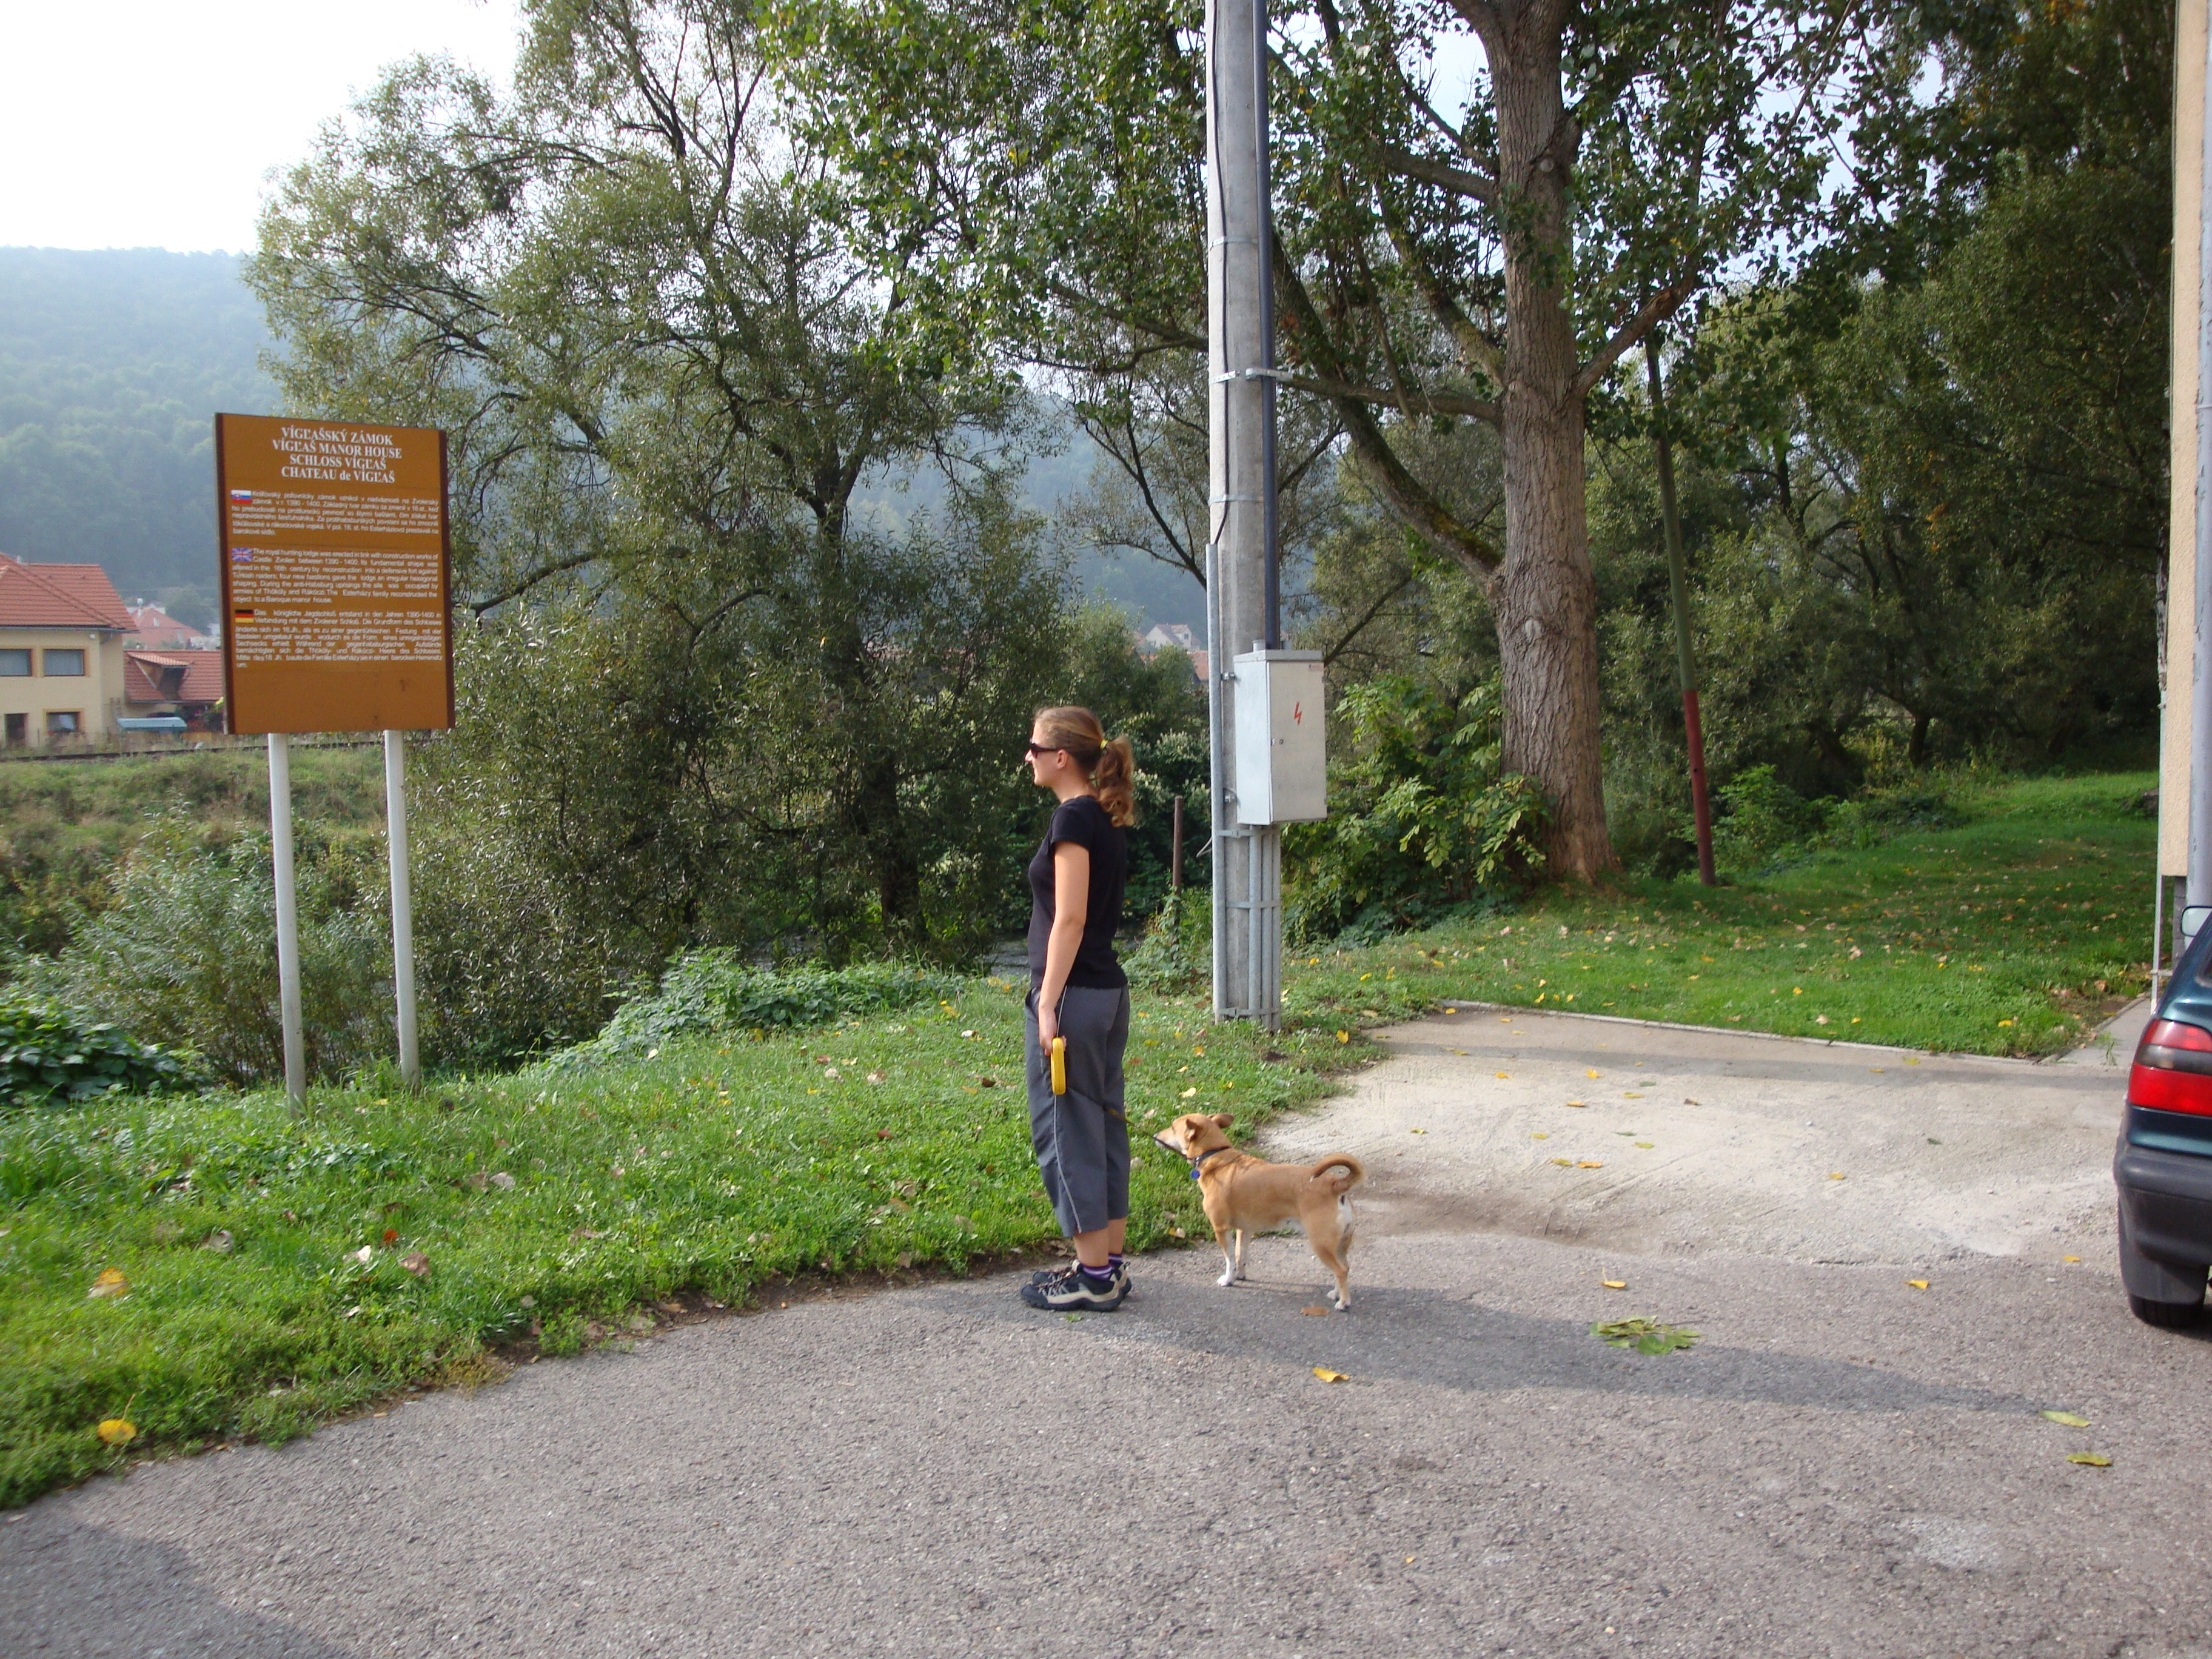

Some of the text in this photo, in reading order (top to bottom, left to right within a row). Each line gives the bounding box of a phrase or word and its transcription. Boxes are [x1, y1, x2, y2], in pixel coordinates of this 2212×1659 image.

[281, 426, 393, 445] VÍGĽAŠSKÝ ZÁMOK
[272, 438, 402, 458] VÍGĽAŠ MANOR HOUSE
[289, 454, 386, 470] SCHLOSS VÍGĽAŠ
[281, 466, 395, 483] CHATEAU de VÍGĽAŠ
